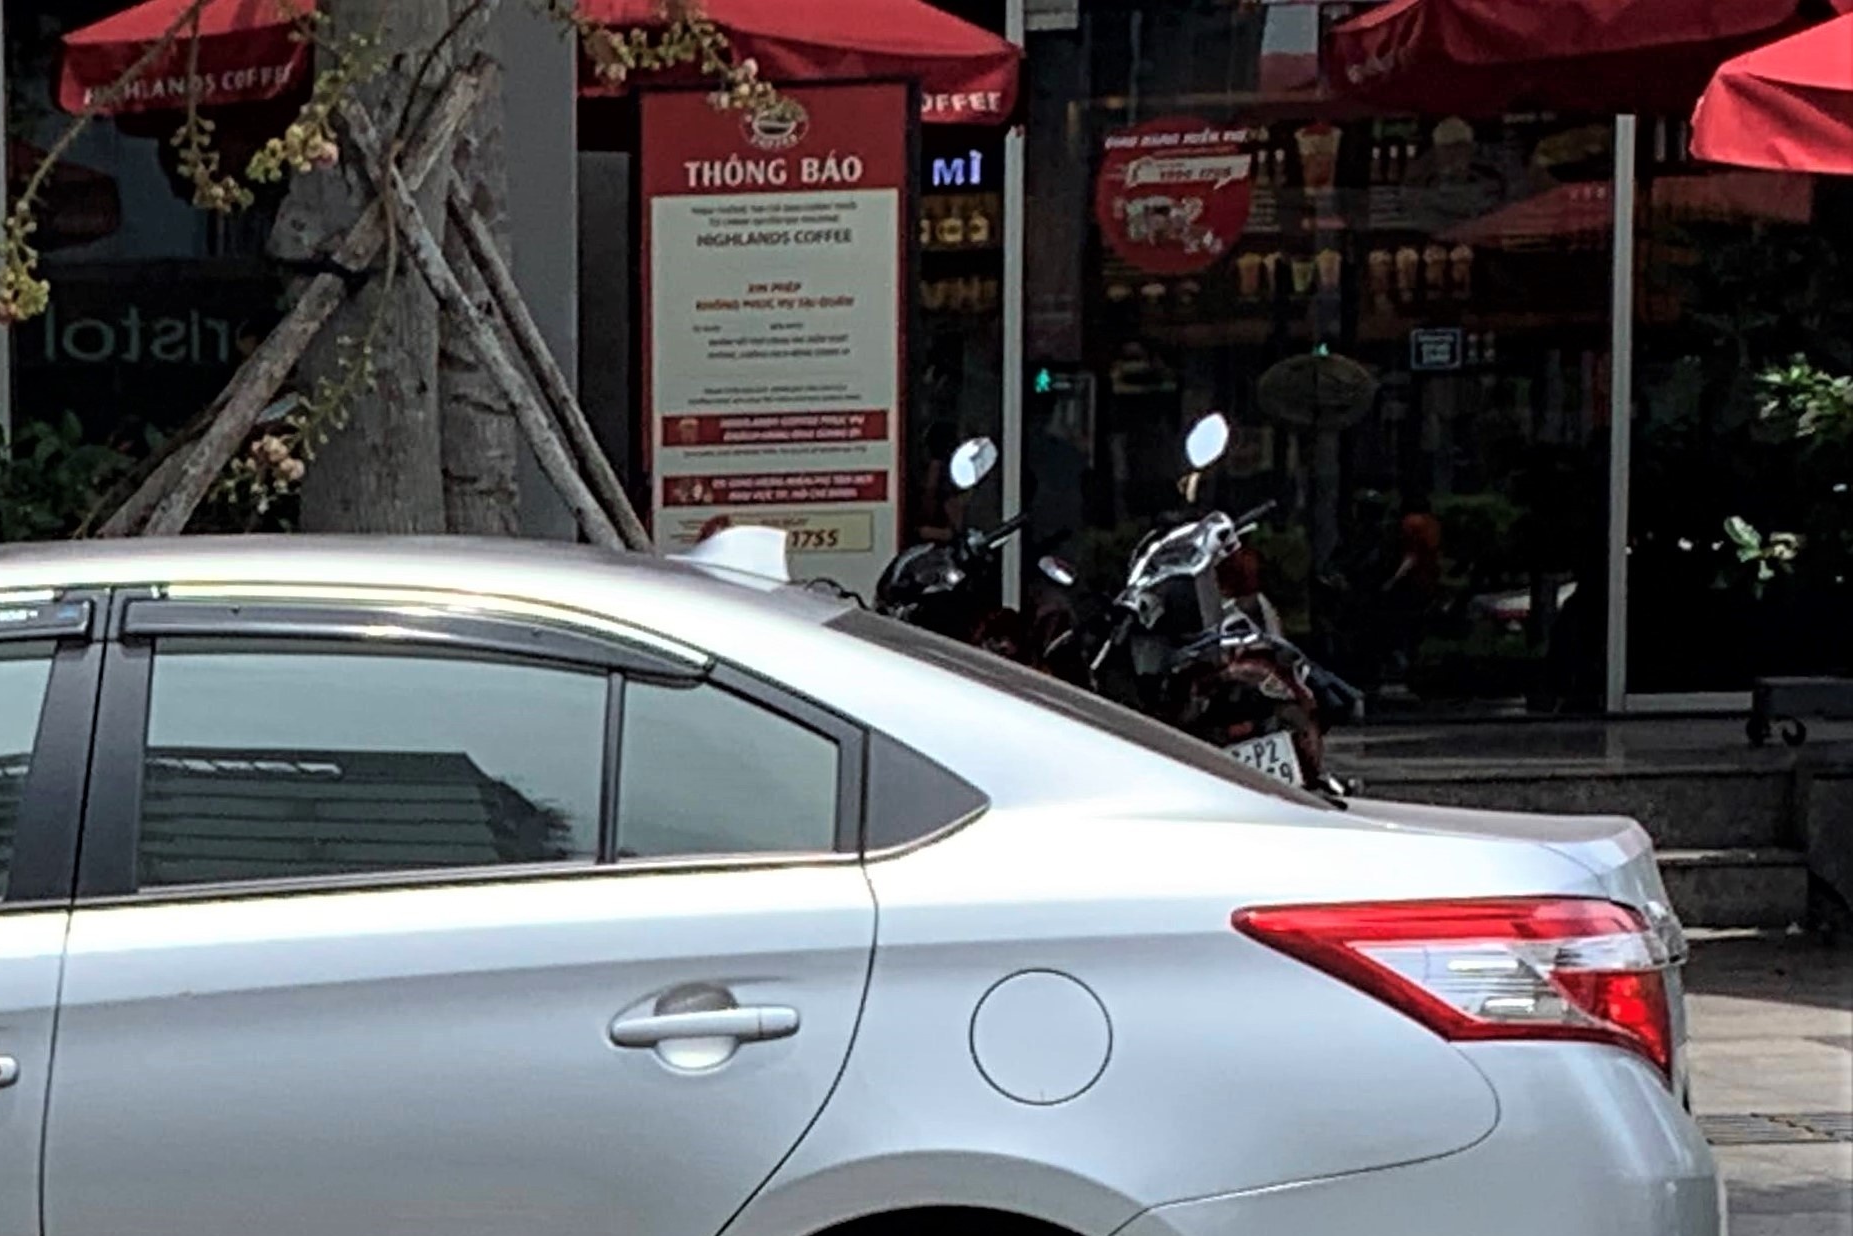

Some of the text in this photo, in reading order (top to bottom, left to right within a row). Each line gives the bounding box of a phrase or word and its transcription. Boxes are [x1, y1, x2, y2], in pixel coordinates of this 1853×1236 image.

[683, 149, 864, 188] THÔNG BÁO
[794, 227, 853, 245] COFFEE
